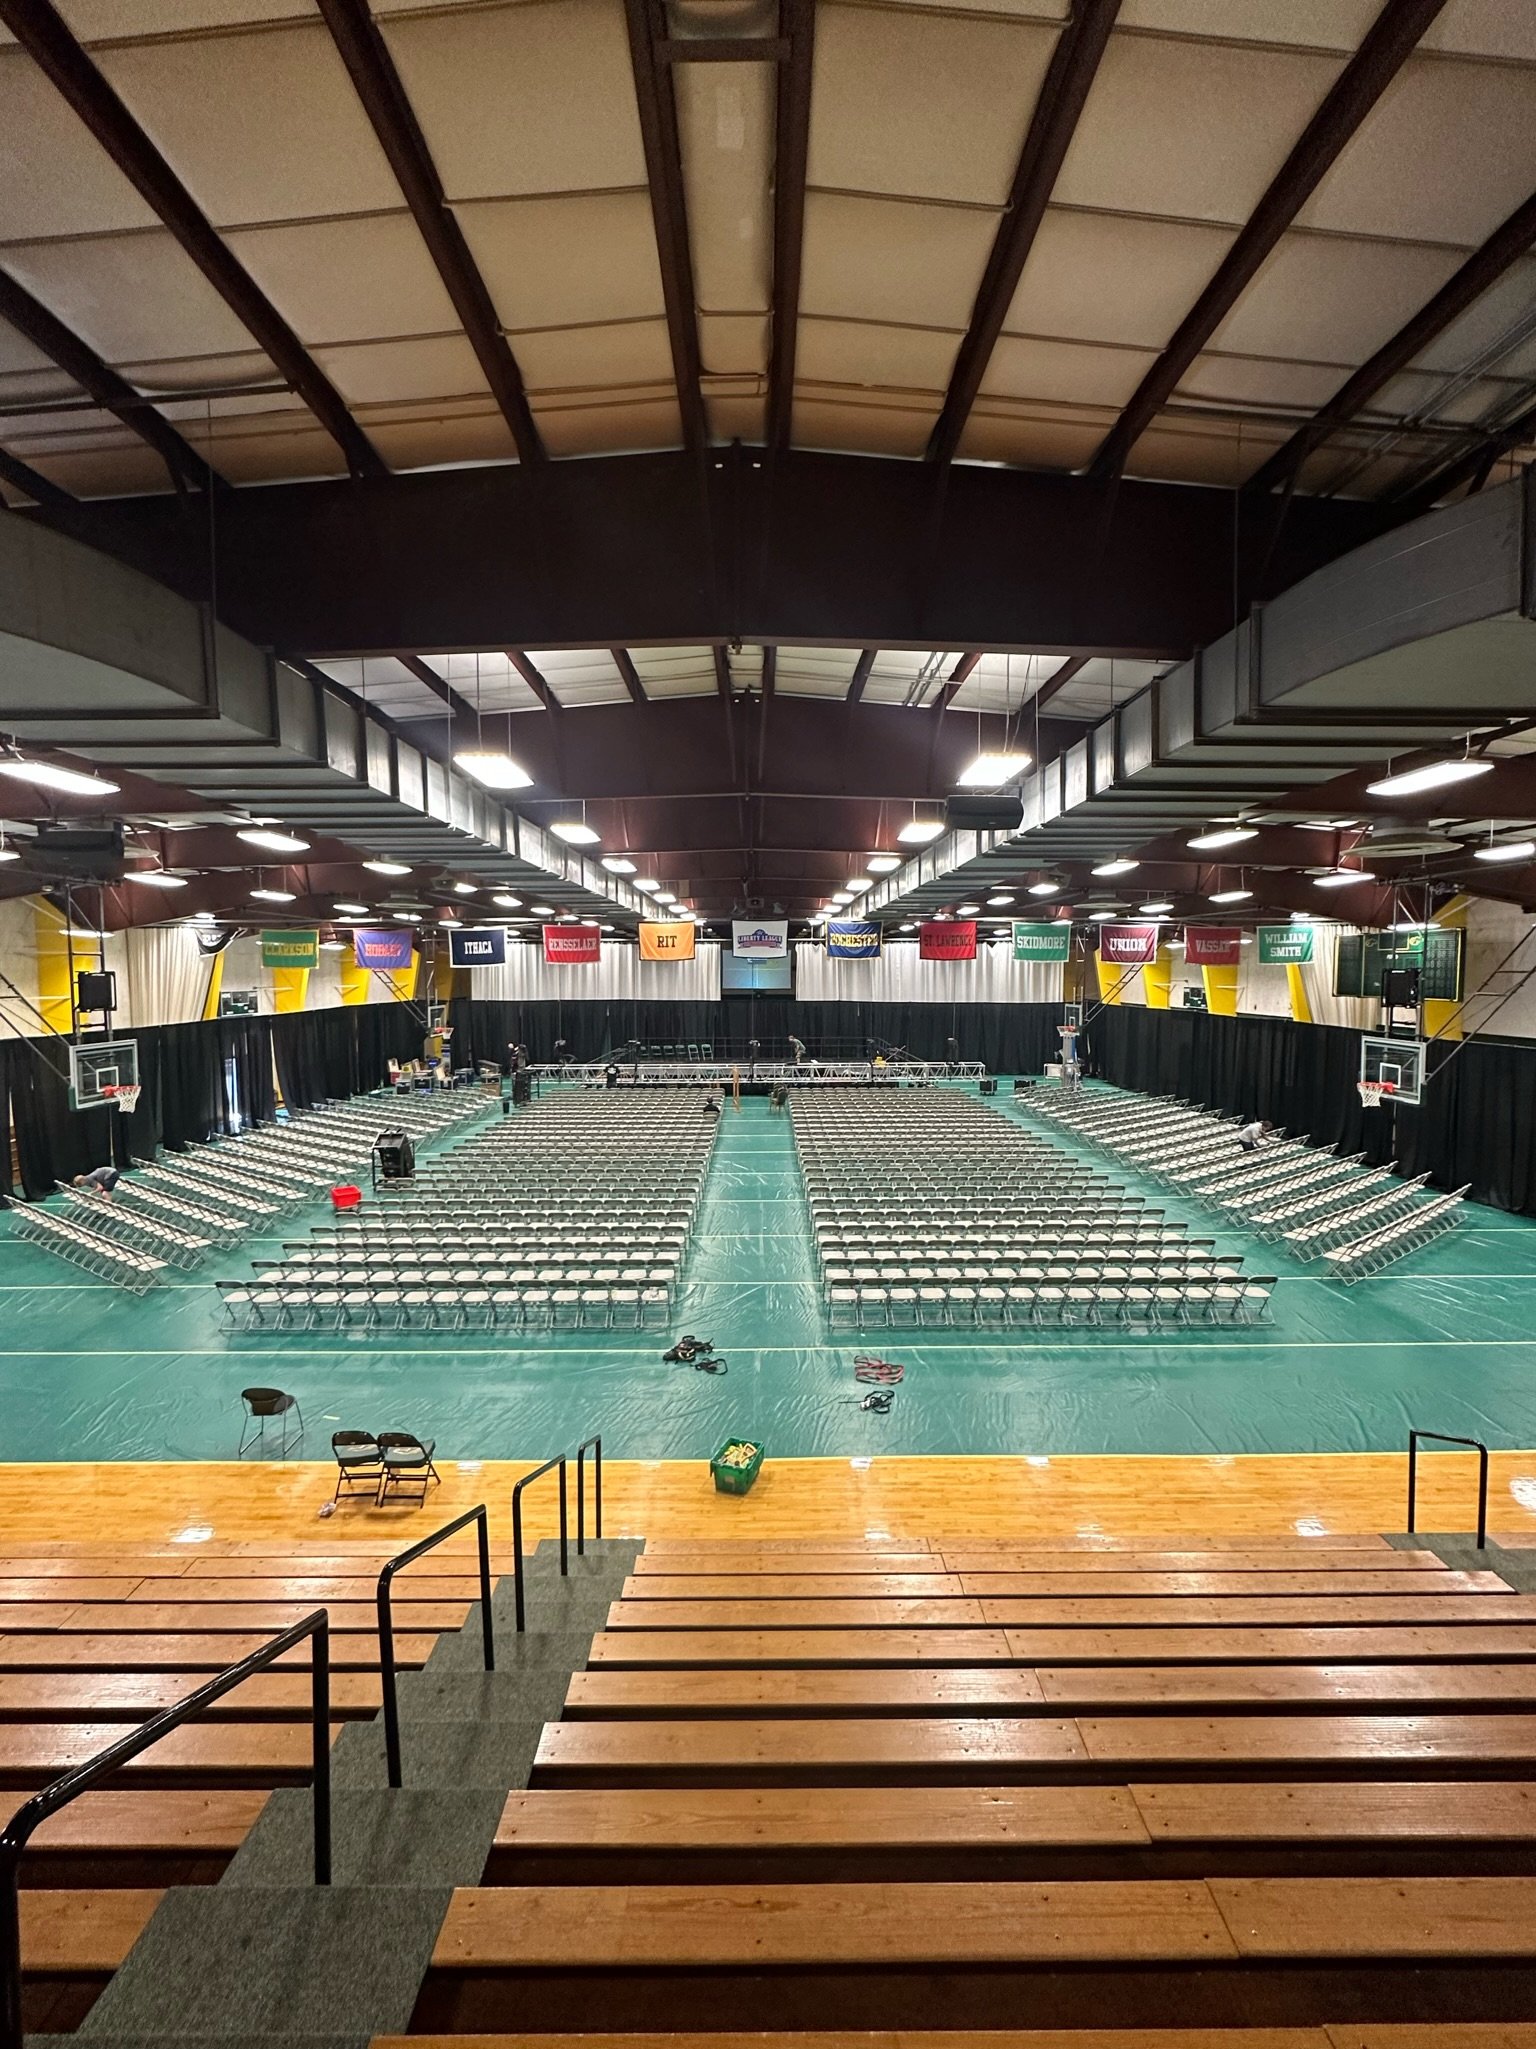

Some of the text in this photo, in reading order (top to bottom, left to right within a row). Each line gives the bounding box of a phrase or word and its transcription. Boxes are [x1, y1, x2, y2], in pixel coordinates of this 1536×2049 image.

[549, 937, 597, 951] RENSSELAER
[656, 935, 678, 948] RIT
[830, 933, 879, 948] ROCHESTER
[1017, 936, 1066, 950] SKIDMORE
[1109, 937, 1148, 952] UNION
[1265, 933, 1308, 944] WILLIAM
[464, 940, 493, 955] ITHACA
[1270, 946, 1302, 957] SMITH
